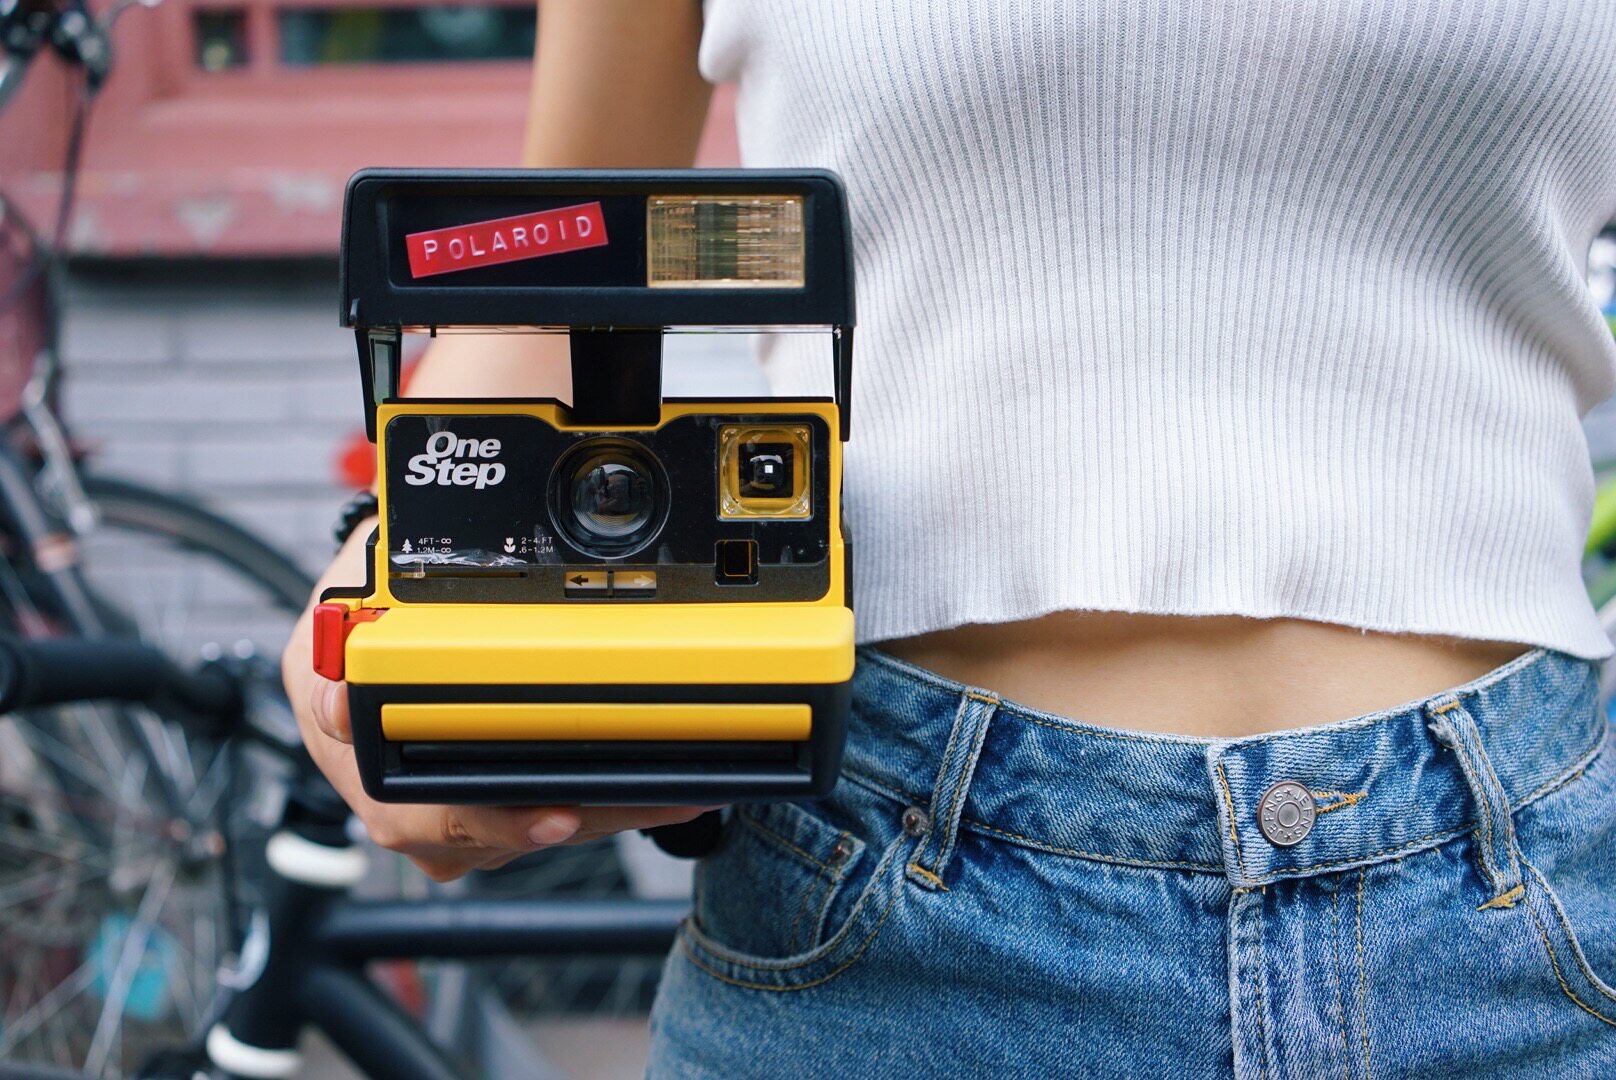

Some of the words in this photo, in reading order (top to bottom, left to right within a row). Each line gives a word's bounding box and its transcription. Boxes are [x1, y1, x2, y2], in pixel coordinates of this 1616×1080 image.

[423, 215, 593, 261] POLAROID
[426, 431, 502, 458] One
[404, 453, 506, 489] Step
